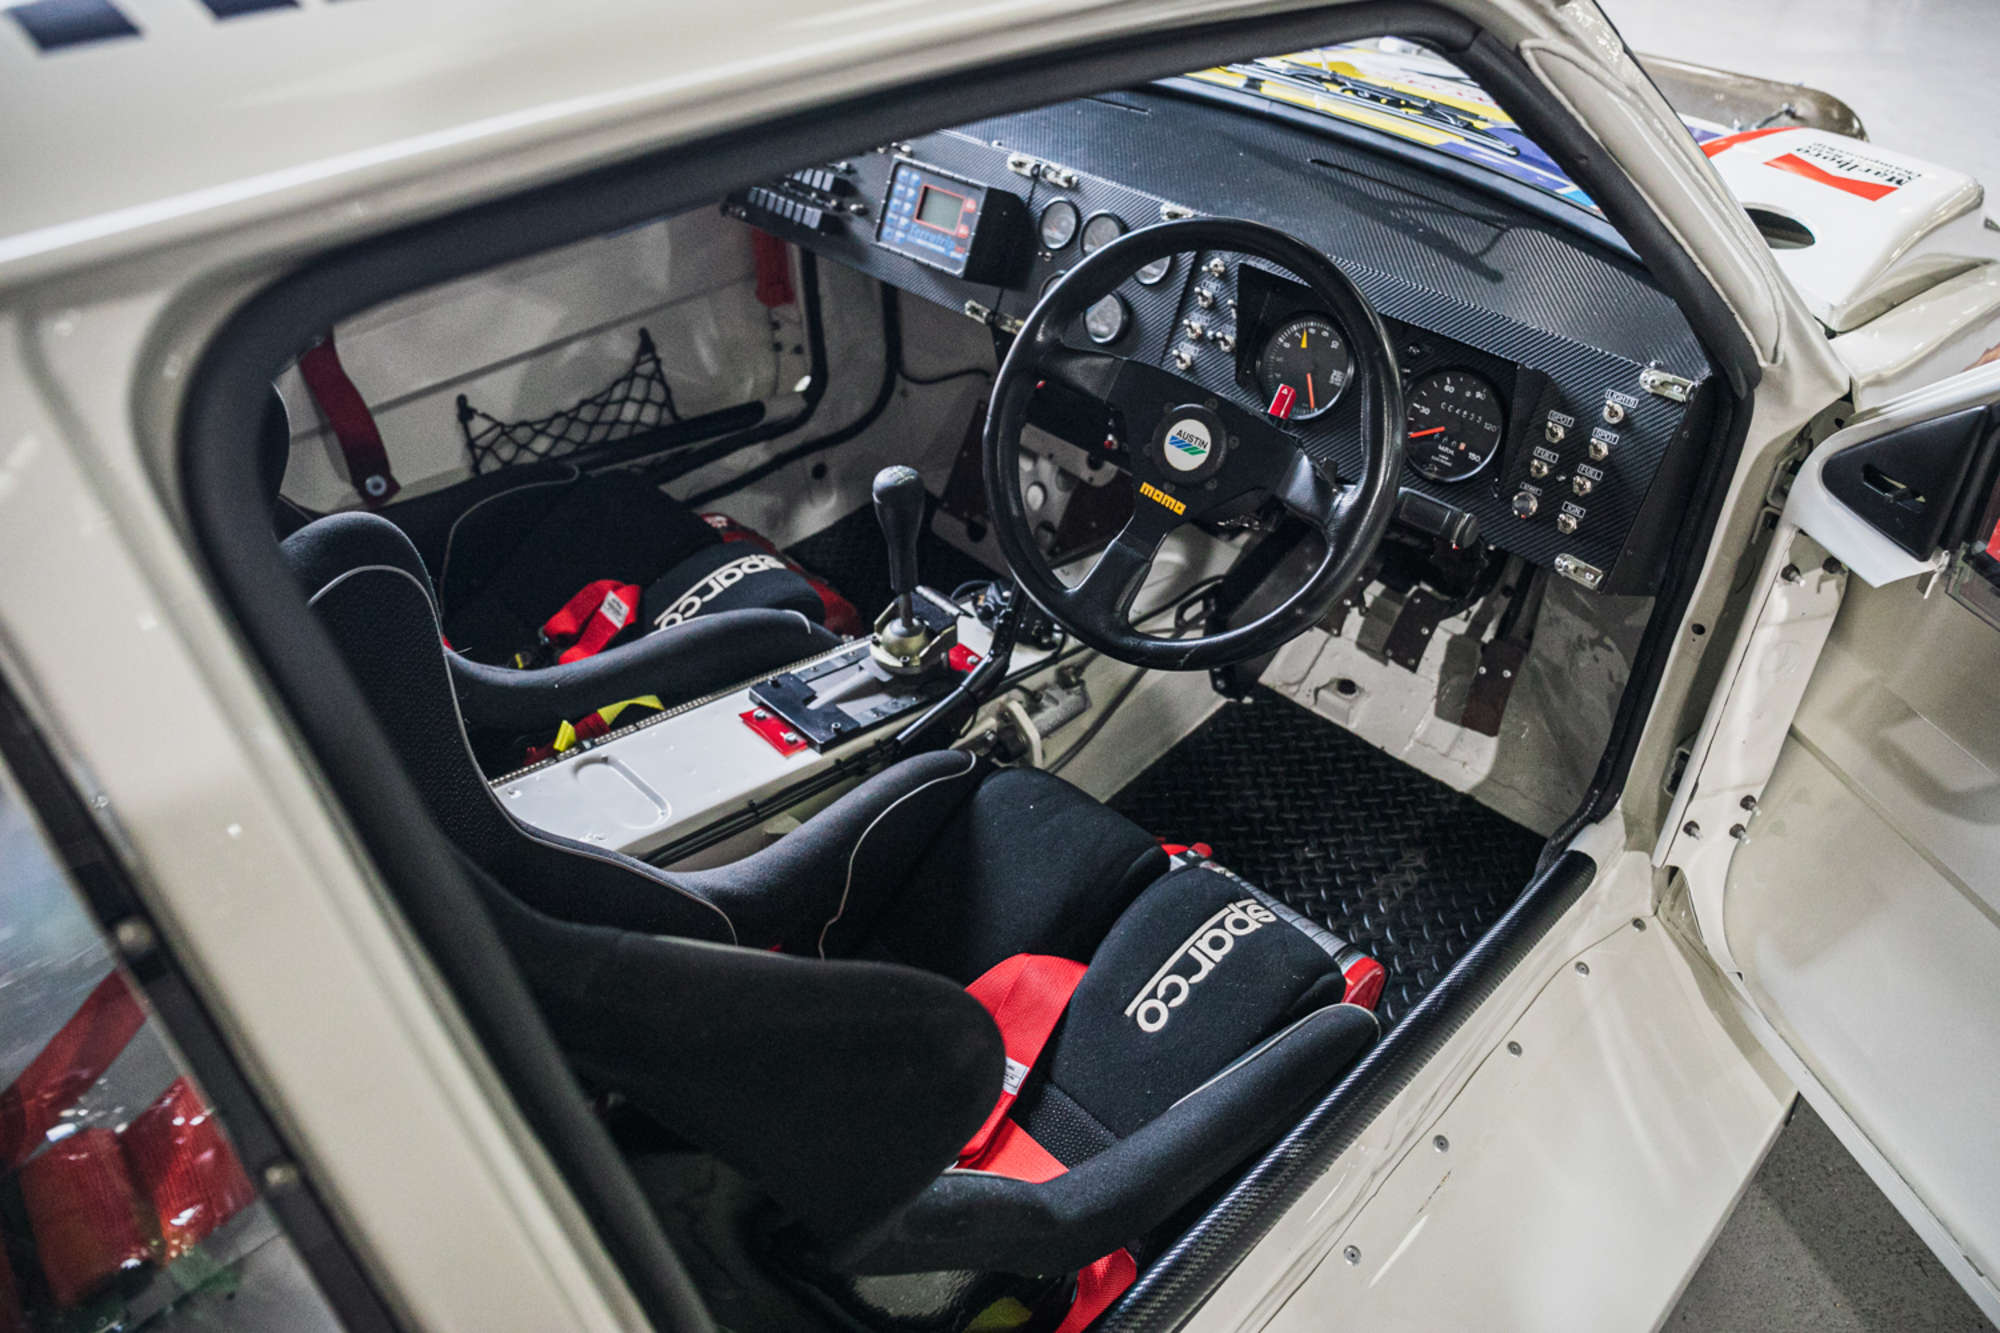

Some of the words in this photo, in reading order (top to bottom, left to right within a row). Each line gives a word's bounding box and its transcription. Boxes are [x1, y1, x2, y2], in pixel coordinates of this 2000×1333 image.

[1796, 147, 1903, 186] Marlboro
[1443, 384, 1455, 394] 60
[1549, 410, 1573, 427] SPOT
[1176, 429, 1209, 450] AUSTIN
[1593, 428, 1618, 444] SPOT
[1534, 447, 1558, 463] FUEL
[1579, 464, 1602, 480] FUEL
[654, 554, 787, 630] sparco
[1125, 899, 1278, 1033] sparco
